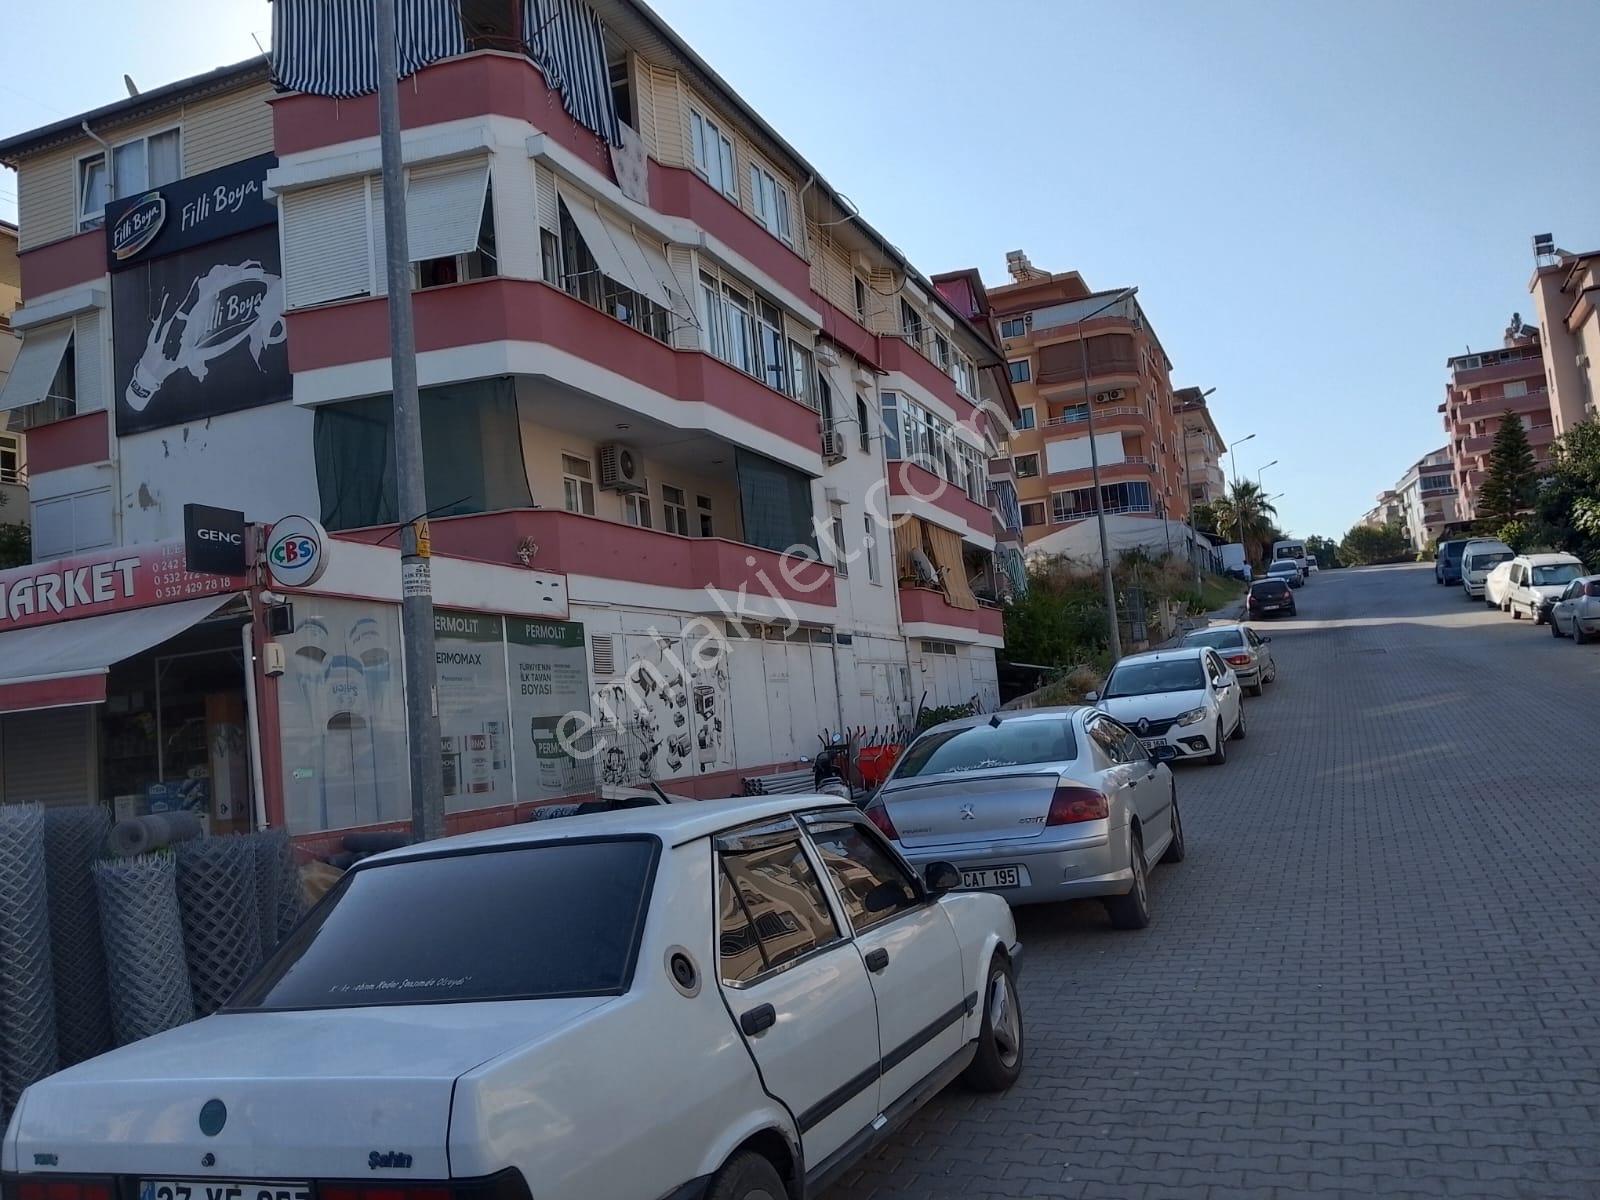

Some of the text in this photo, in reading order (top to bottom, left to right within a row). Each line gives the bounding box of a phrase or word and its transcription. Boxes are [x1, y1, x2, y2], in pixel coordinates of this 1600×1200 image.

[181, 180, 258, 232] Filli Boya
[114, 206, 159, 247] Filli Boya
[227, 292, 263, 321] Boya
[197, 528, 241, 546] GENÇ
[162, 559, 178, 571] 242
[156, 576, 231, 599] 0 537 429 78 18
[164, 572, 181, 584] 532
[0, 557, 140, 622] ARKET
[436, 652, 482, 665] ERMOMAX
[521, 684, 552, 696] BOYASI
[963, 869, 1016, 888] CAT 195
